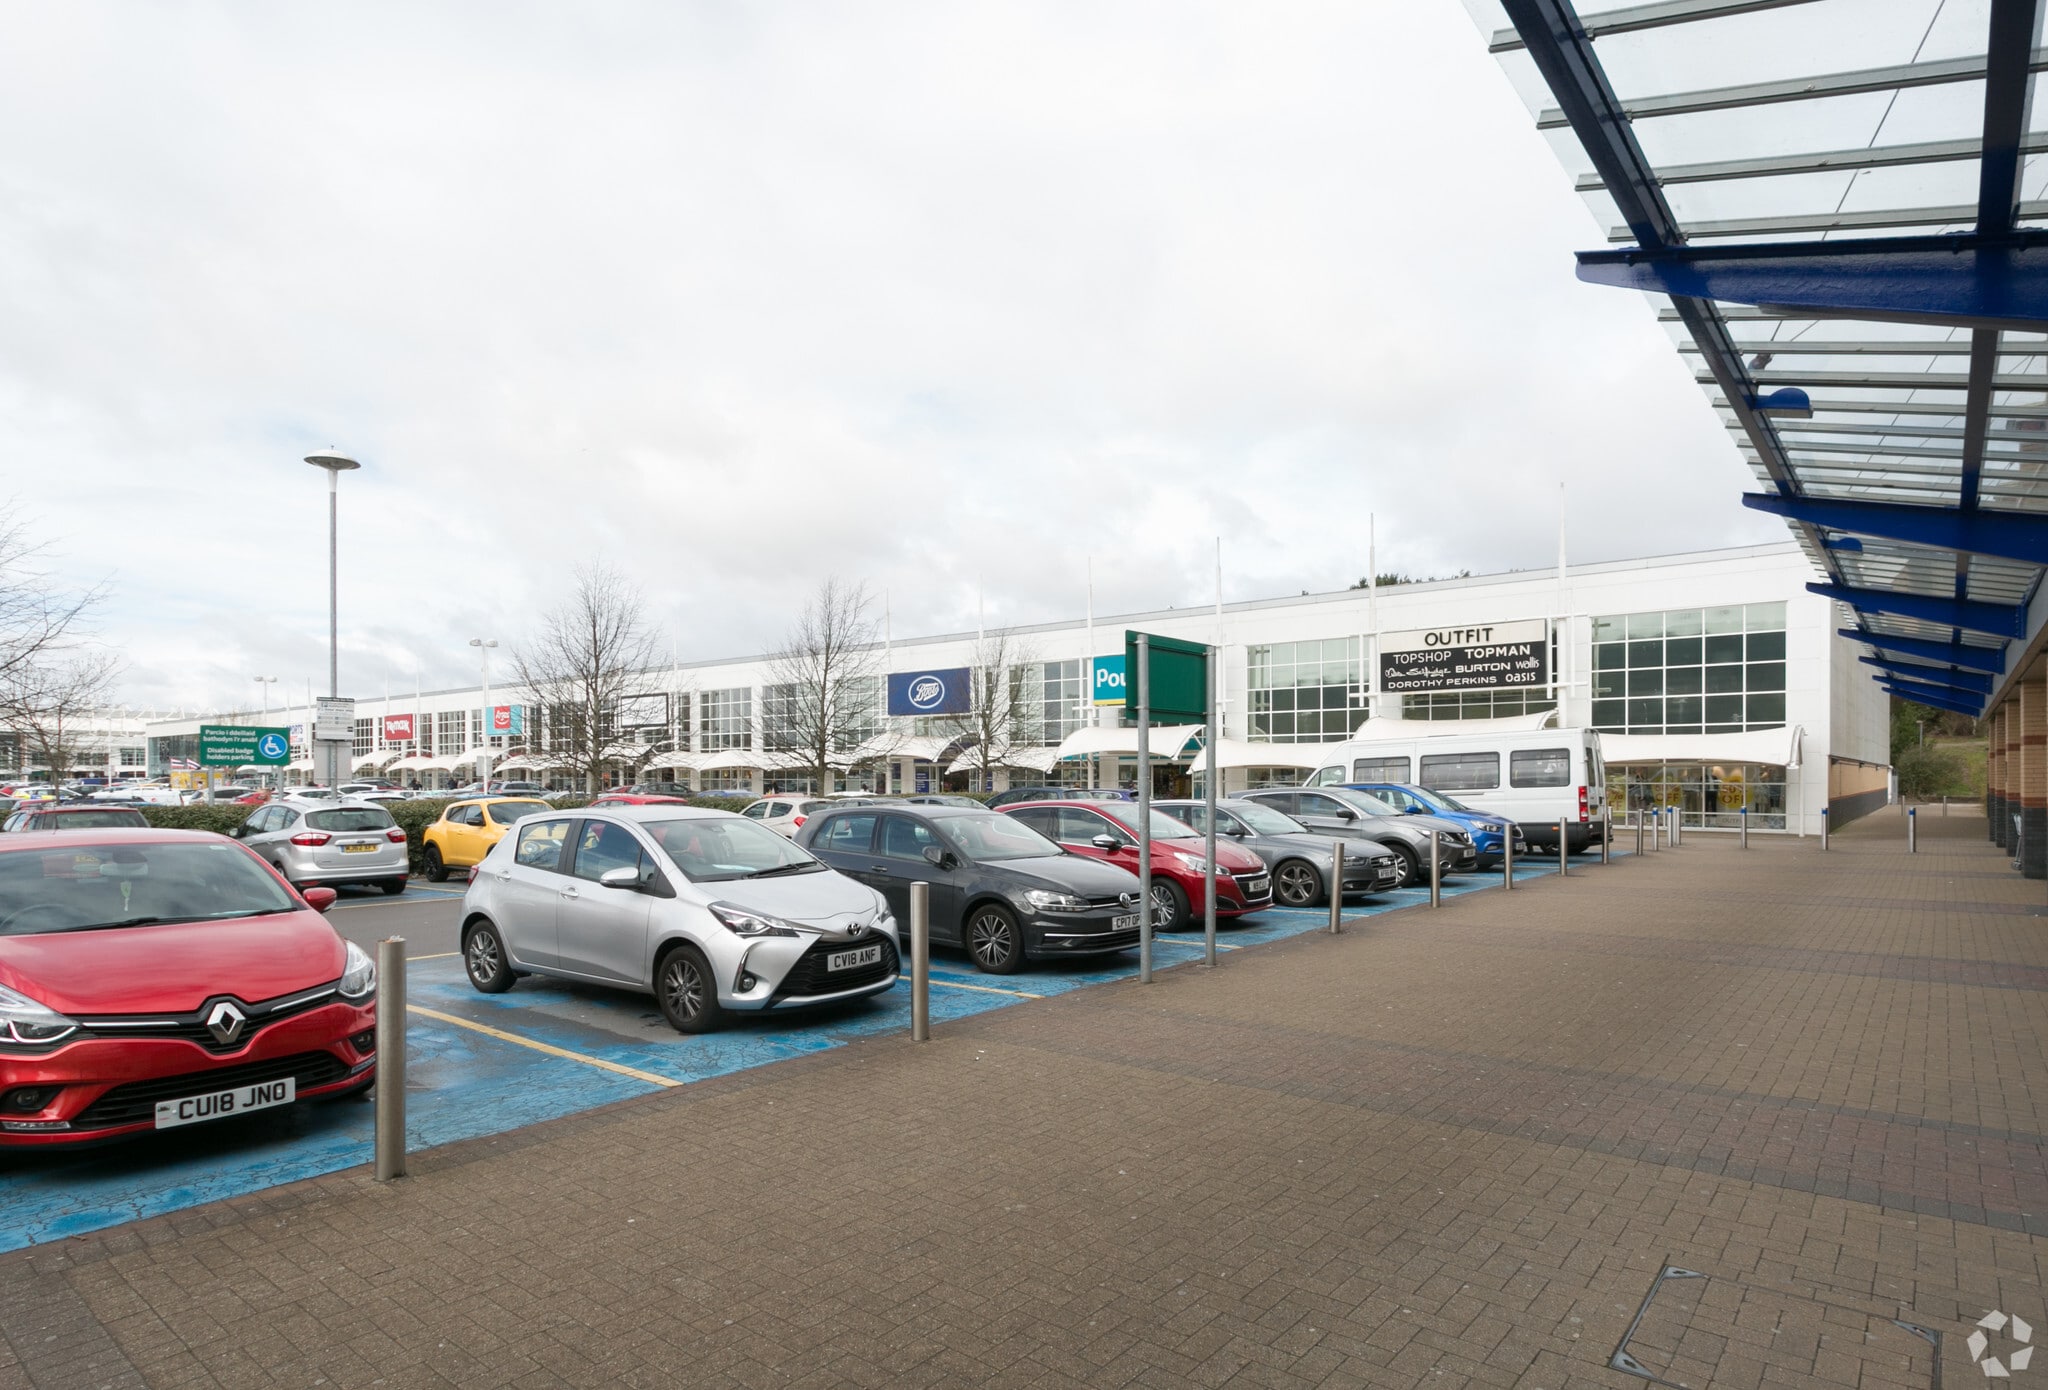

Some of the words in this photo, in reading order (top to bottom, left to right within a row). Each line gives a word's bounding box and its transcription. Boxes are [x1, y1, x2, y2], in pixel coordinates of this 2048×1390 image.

[1424, 627, 1494, 646] OUTFIT
[1393, 650, 1452, 665] TOPSHOP
[1464, 644, 1531, 659] TOPMAN
[1455, 662, 1511, 673] BURTON
[1515, 656, 1540, 669] wallis
[1388, 679, 1443, 689] DOROTHY
[1446, 676, 1497, 686] PERKINS
[1505, 672, 1536, 682] oasis
[914, 682, 939, 702] Boots
[834, 952, 857, 968] CV18
[859, 948, 876, 964] ANF
[179, 1092, 234, 1120] CU18
[243, 1082, 286, 1108] JNO
